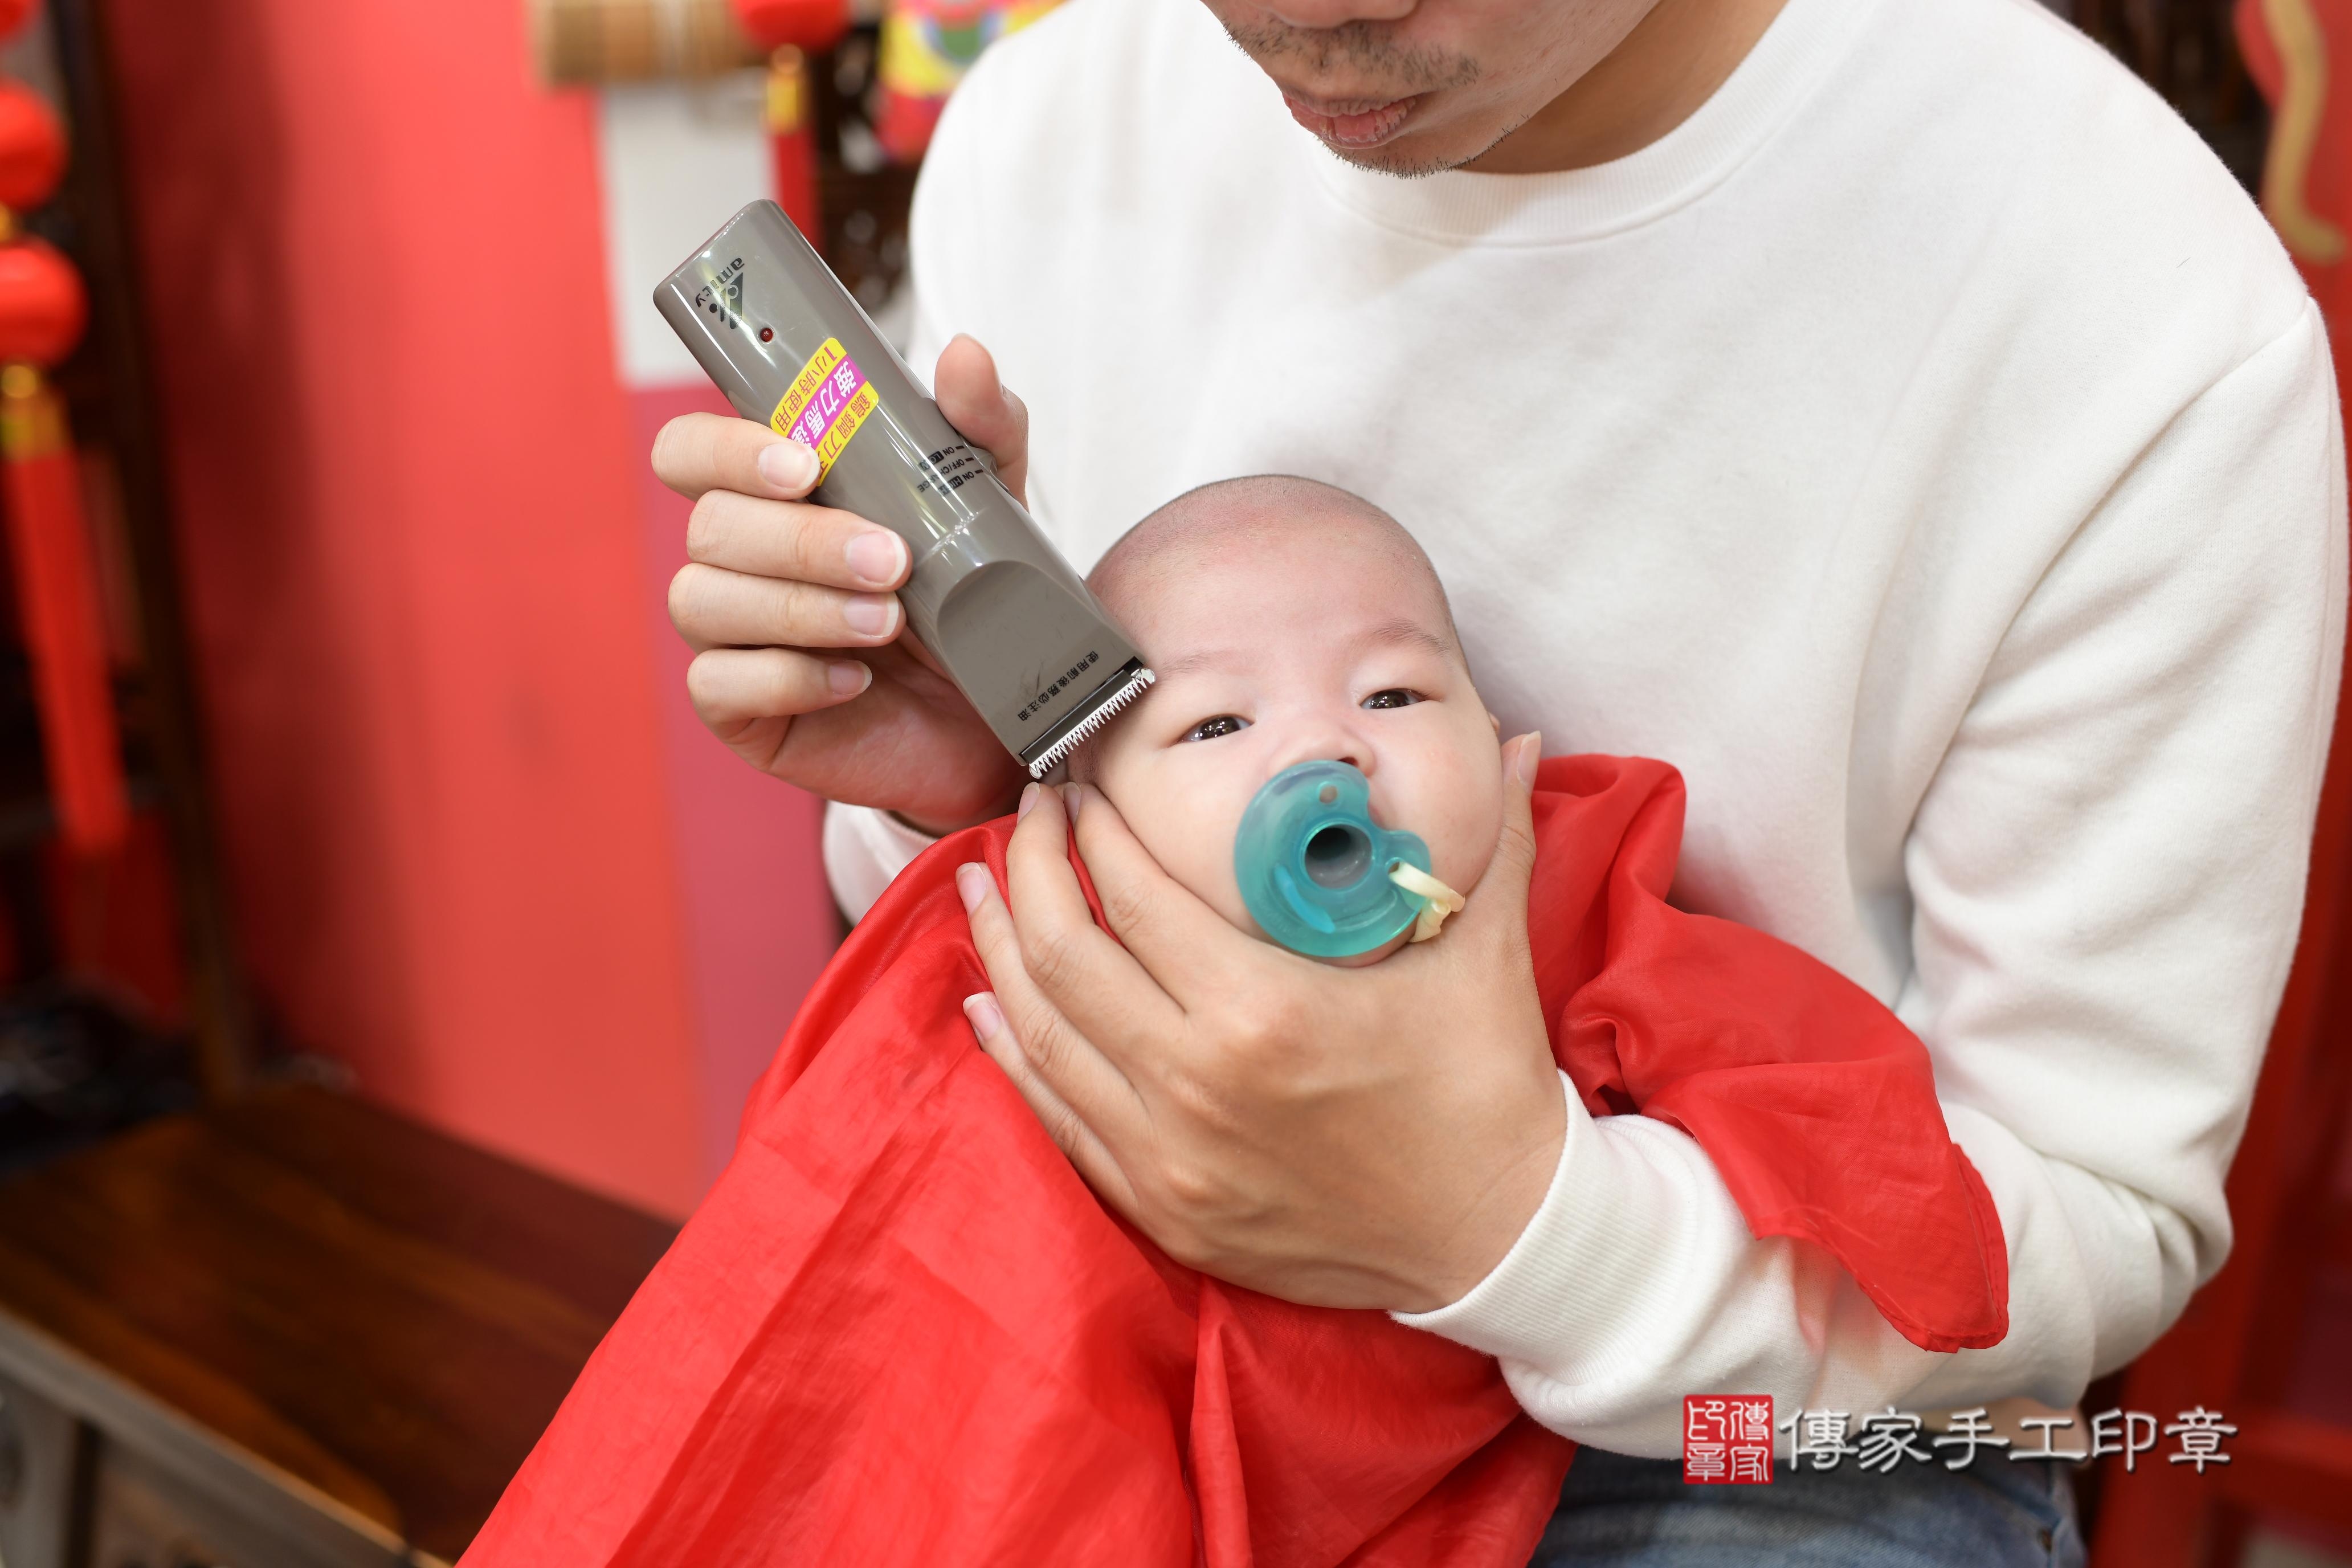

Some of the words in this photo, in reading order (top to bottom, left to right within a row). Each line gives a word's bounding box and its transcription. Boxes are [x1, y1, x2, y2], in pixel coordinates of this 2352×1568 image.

[695, 258, 745, 308] amity
[775, 346, 838, 431] 1小時使用
[942, 447, 954, 455] ON
[962, 471, 974, 481] ON
[1017, 651, 1099, 721] 使用前後務必注油
